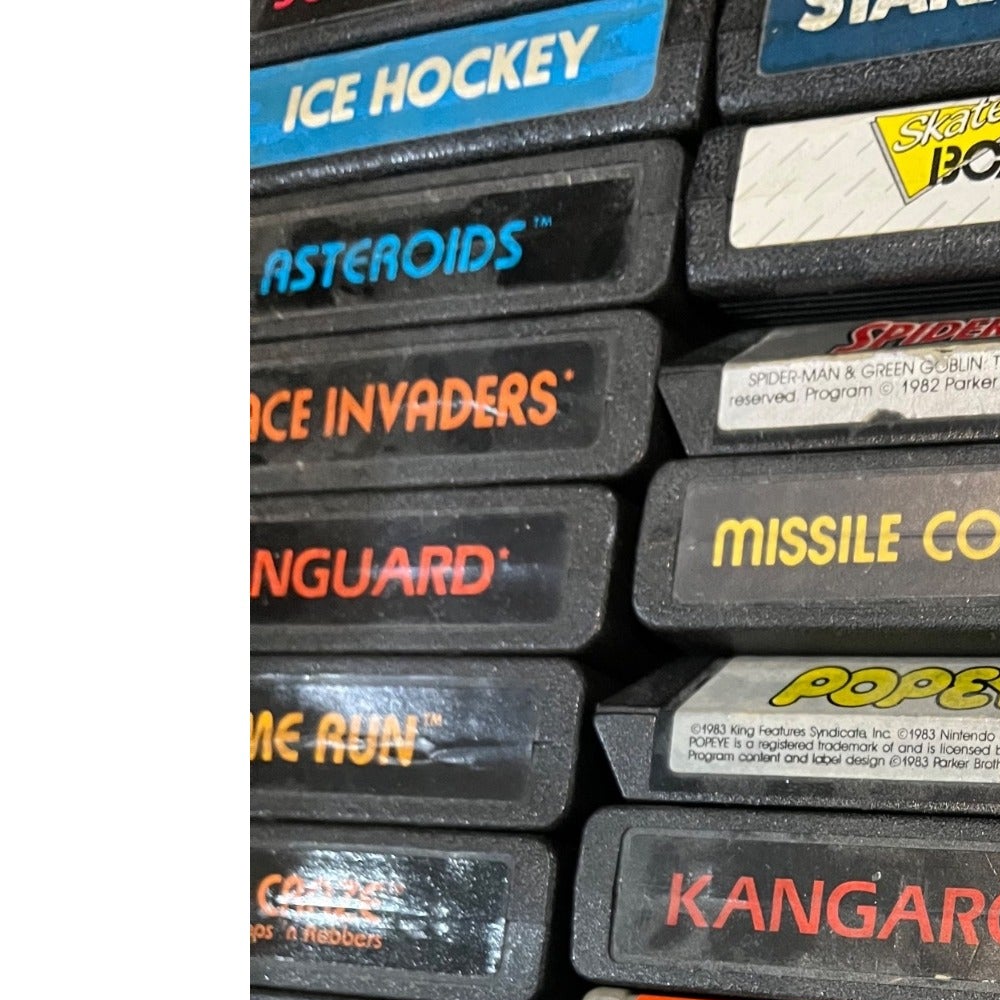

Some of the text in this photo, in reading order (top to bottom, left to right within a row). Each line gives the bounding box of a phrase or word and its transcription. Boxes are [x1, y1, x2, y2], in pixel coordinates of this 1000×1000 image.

[283, 25, 600, 133] ICE HOCKEY
[845, 365, 856, 379] &
[861, 359, 915, 379] GREEN
[805, 383, 873, 402] Program
[903, 378, 939, 393] 1982
[945, 374, 998, 391] Parker
[712, 513, 902, 567] MISSILE
[731, 725, 755, 738] King
[759, 725, 806, 738] Features
[940, 729, 996, 743] Nintendo
[689, 736, 730, 749] POPEYE
[734, 738, 742, 749] is
[746, 739, 754, 749] a
[758, 739, 814, 752] registered
[818, 740, 878, 753] trademark
[883, 741, 894, 753] of
[898, 743, 922, 755] and
[927, 743, 936, 755] is
[940, 743, 991, 757] licensed
[688, 750, 735, 764] Program
[738, 752, 781, 764] content
[784, 752, 809, 764] and
[812, 752, 842, 765] label
[845, 753, 886, 768] design
[933, 756, 969, 769] Parker
